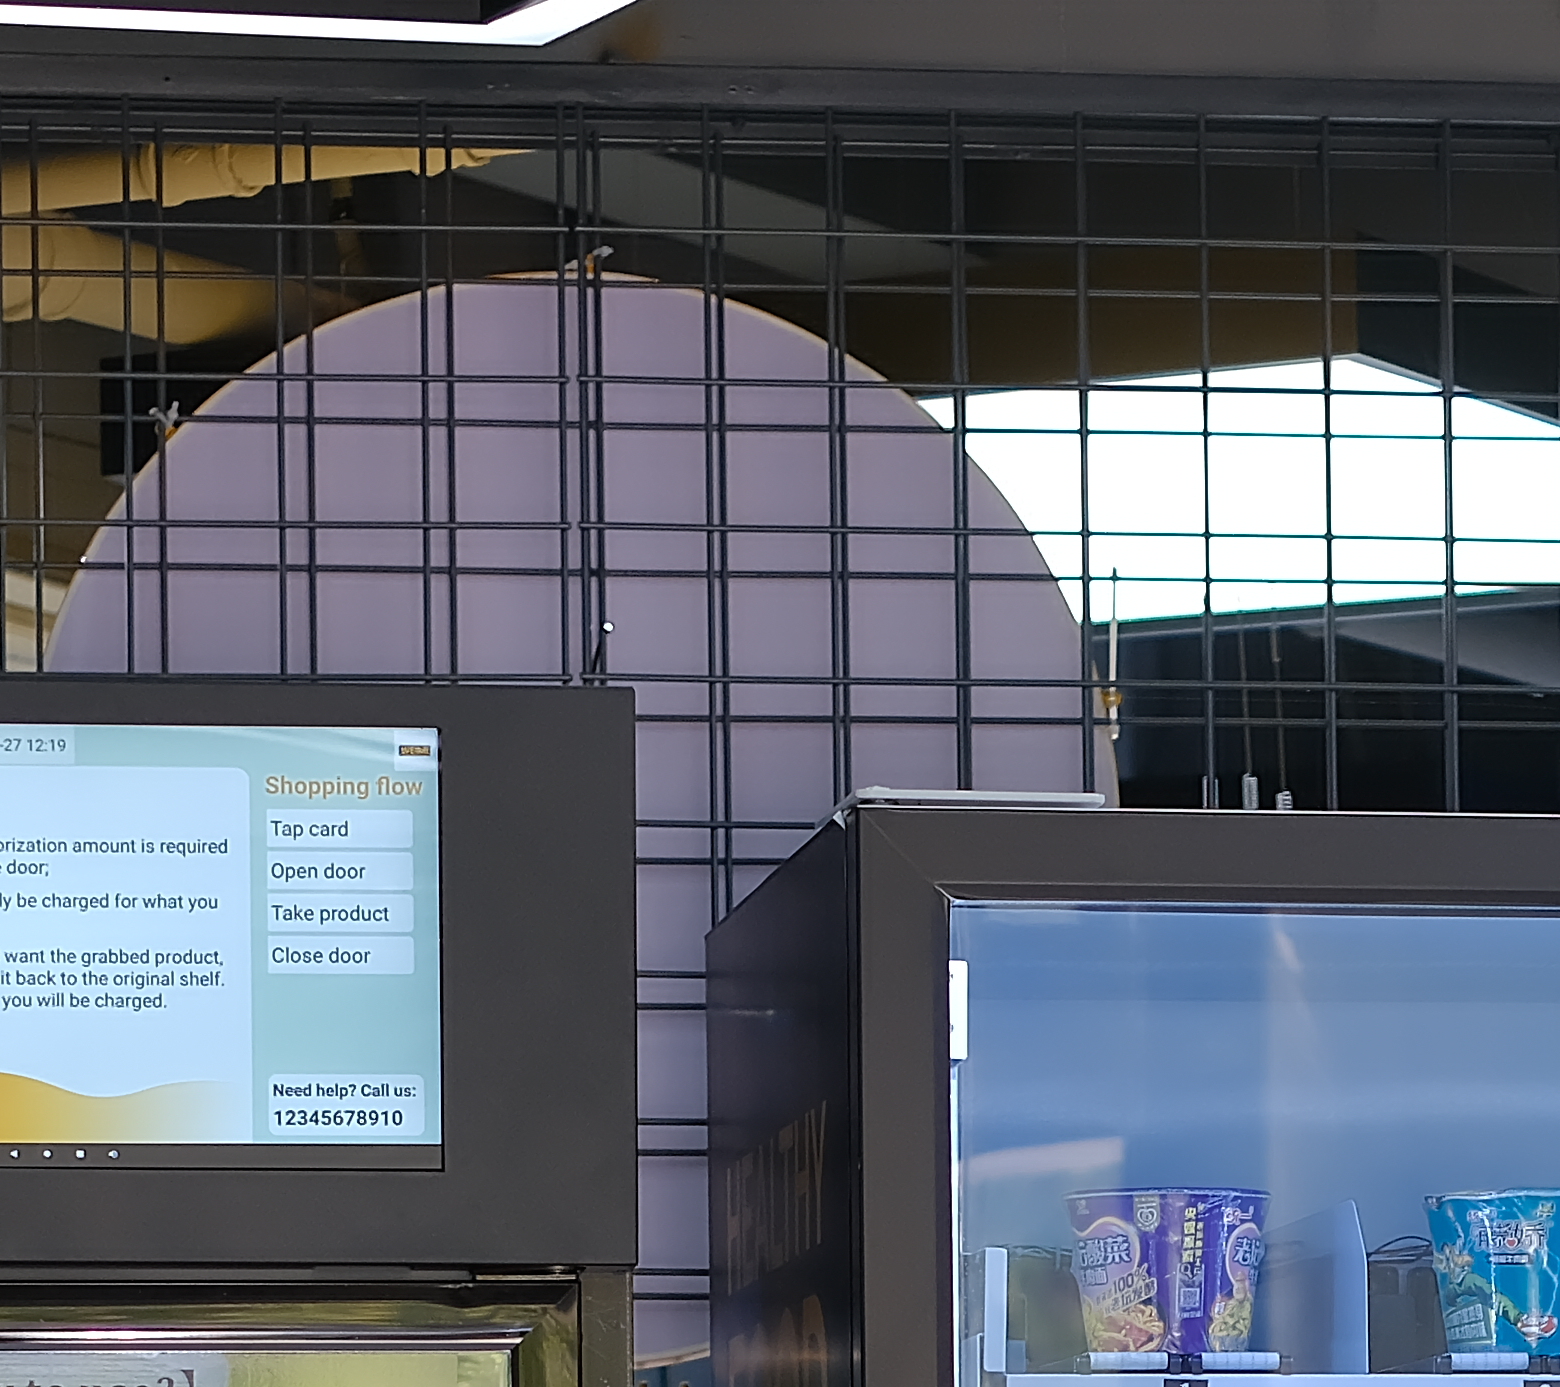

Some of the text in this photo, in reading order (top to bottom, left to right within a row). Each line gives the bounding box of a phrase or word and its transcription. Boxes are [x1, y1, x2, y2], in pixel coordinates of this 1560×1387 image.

[26, 738, 67, 753] 12:19
[264, 774, 423, 801] Shopping flow
[270, 820, 349, 841] Tap card
[72, 839, 137, 854] amount
[141, 838, 155, 854] is
[160, 838, 228, 858] required
[271, 862, 366, 883] Open door
[270, 903, 390, 926] Take product
[271, 946, 371, 964] Close door
[272, 1082, 417, 1101] Need help? Call us:
[274, 1109, 403, 1127] 12345678910
